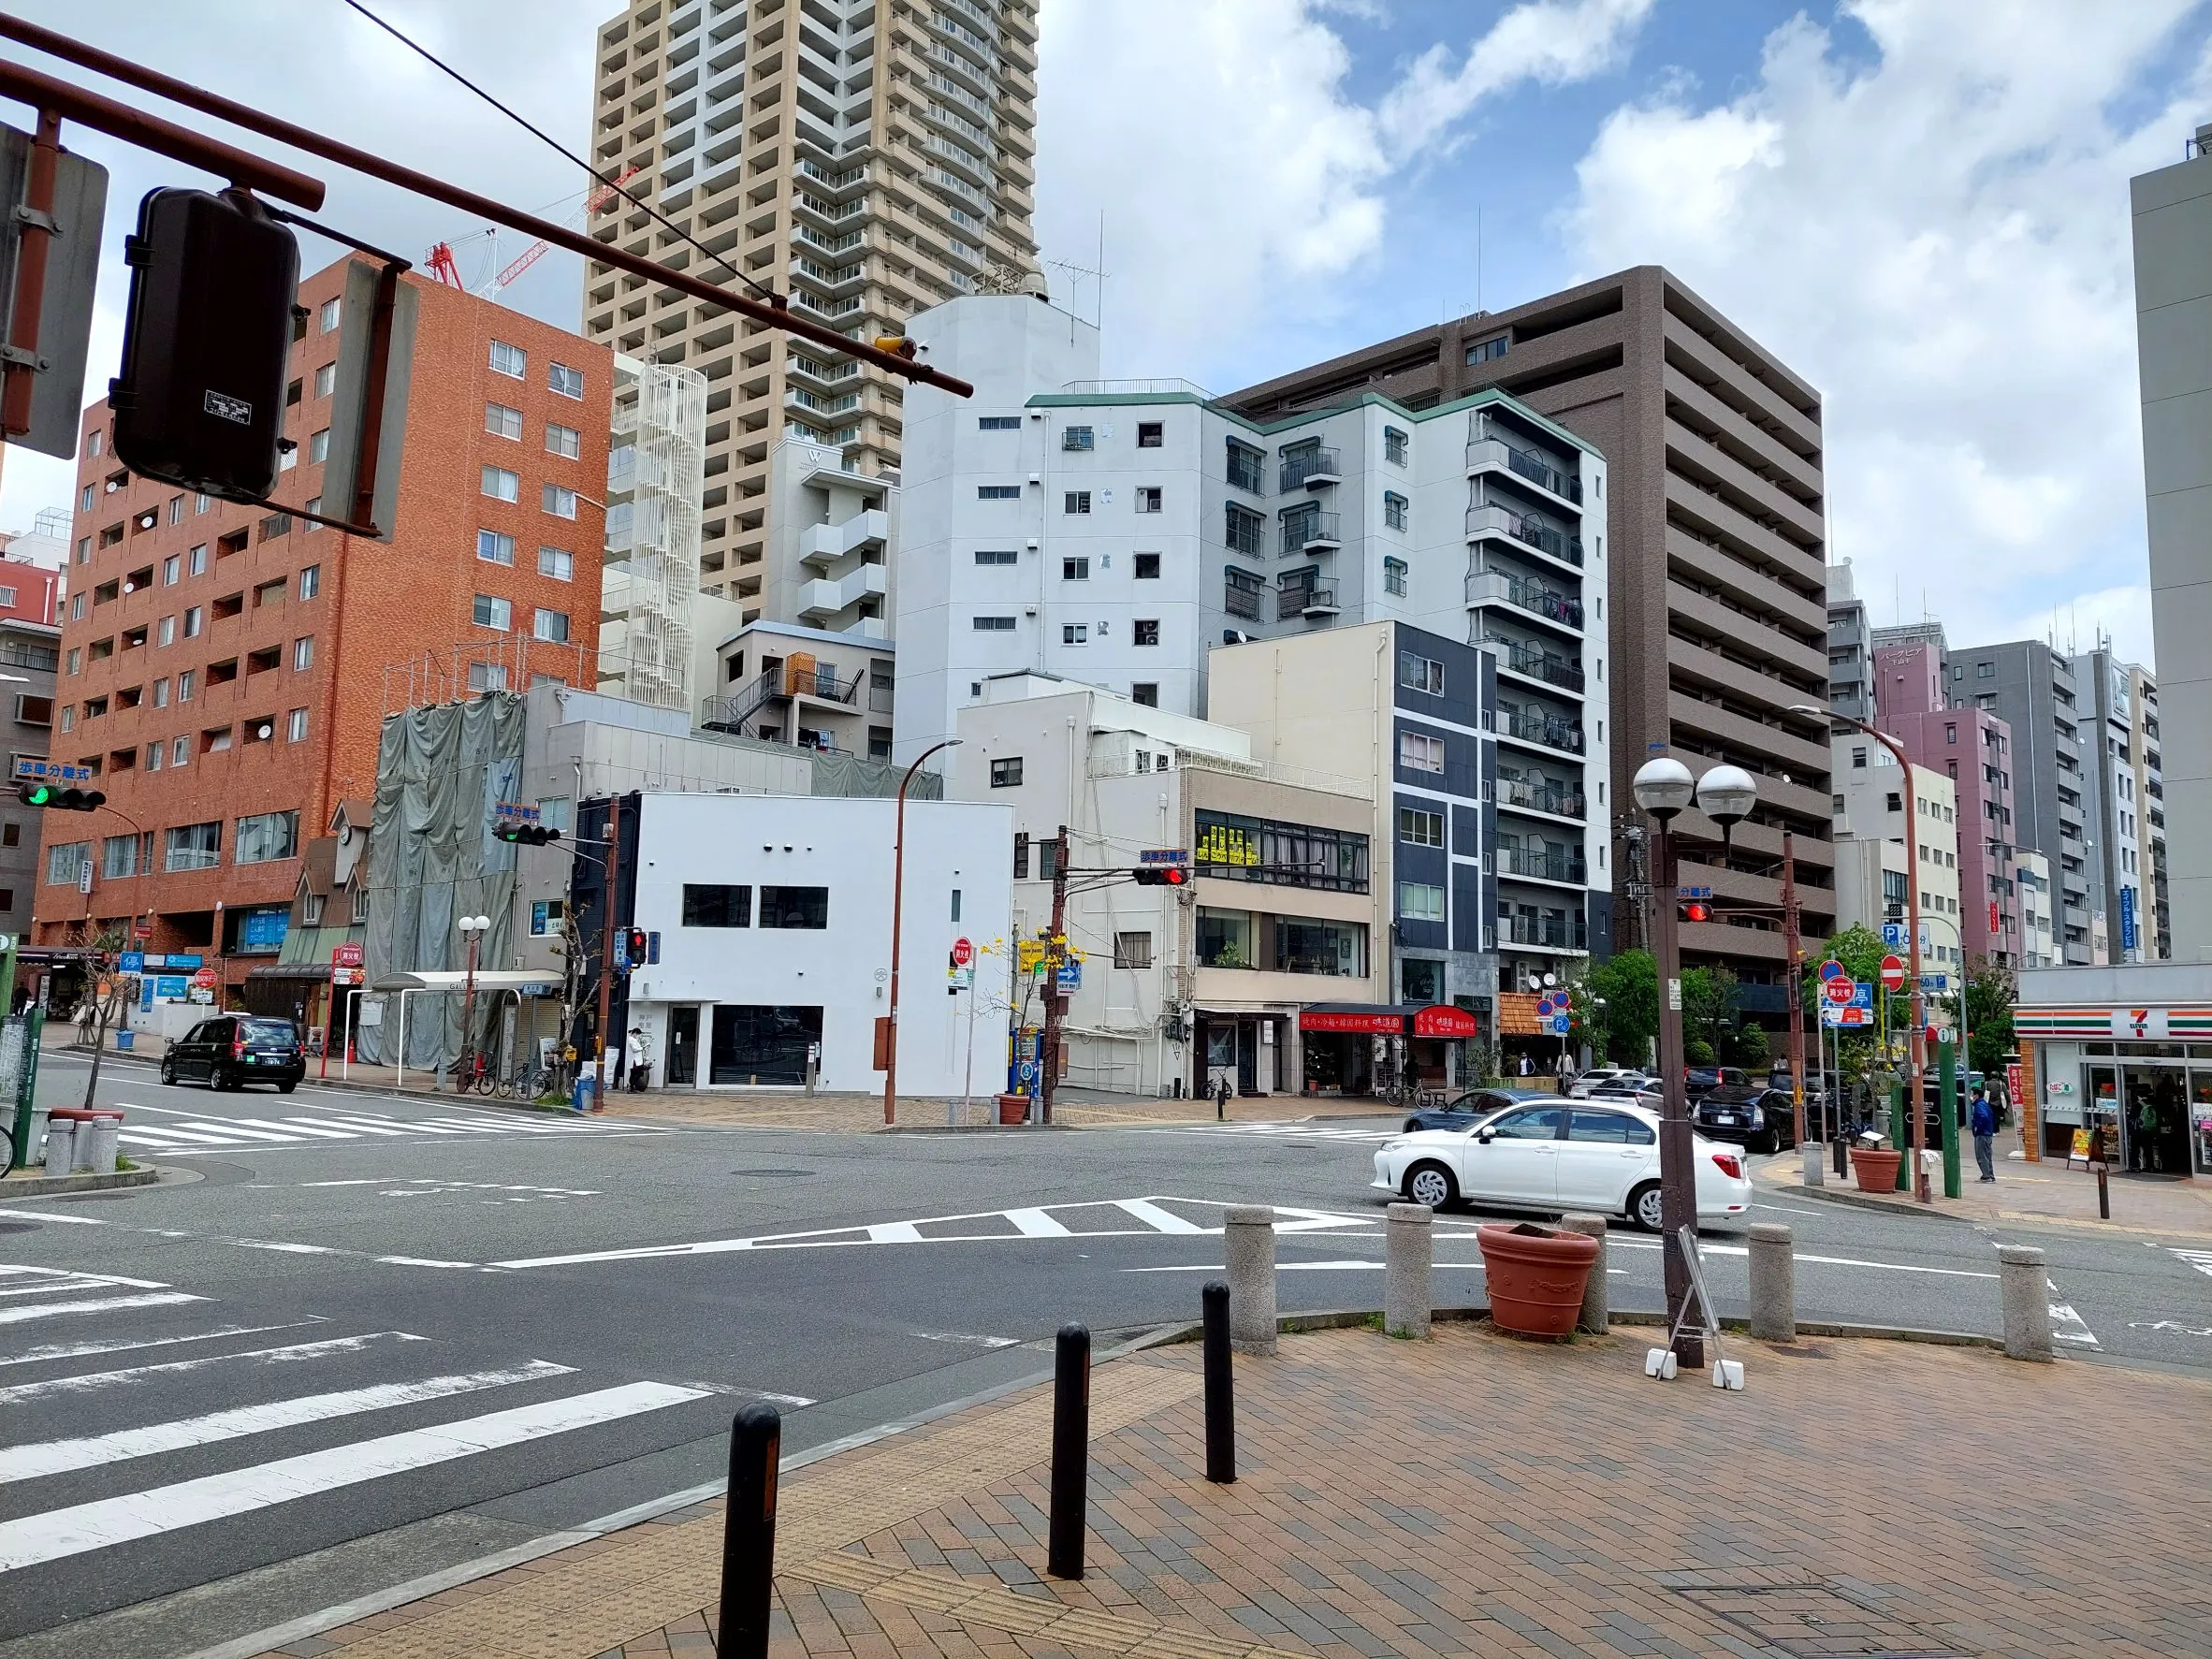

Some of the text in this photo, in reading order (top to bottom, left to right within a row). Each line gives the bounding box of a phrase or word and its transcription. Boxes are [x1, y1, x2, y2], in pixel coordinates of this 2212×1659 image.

[19, 761, 90, 780] 歩車分離式
[495, 805, 540, 820] 歩車分離式
[1142, 851, 1187, 862] 歩車分離式
[1677, 887, 1711, 897] 分離式
[124, 955, 139, 968] 停
[1829, 988, 1851, 997] 消火栓
